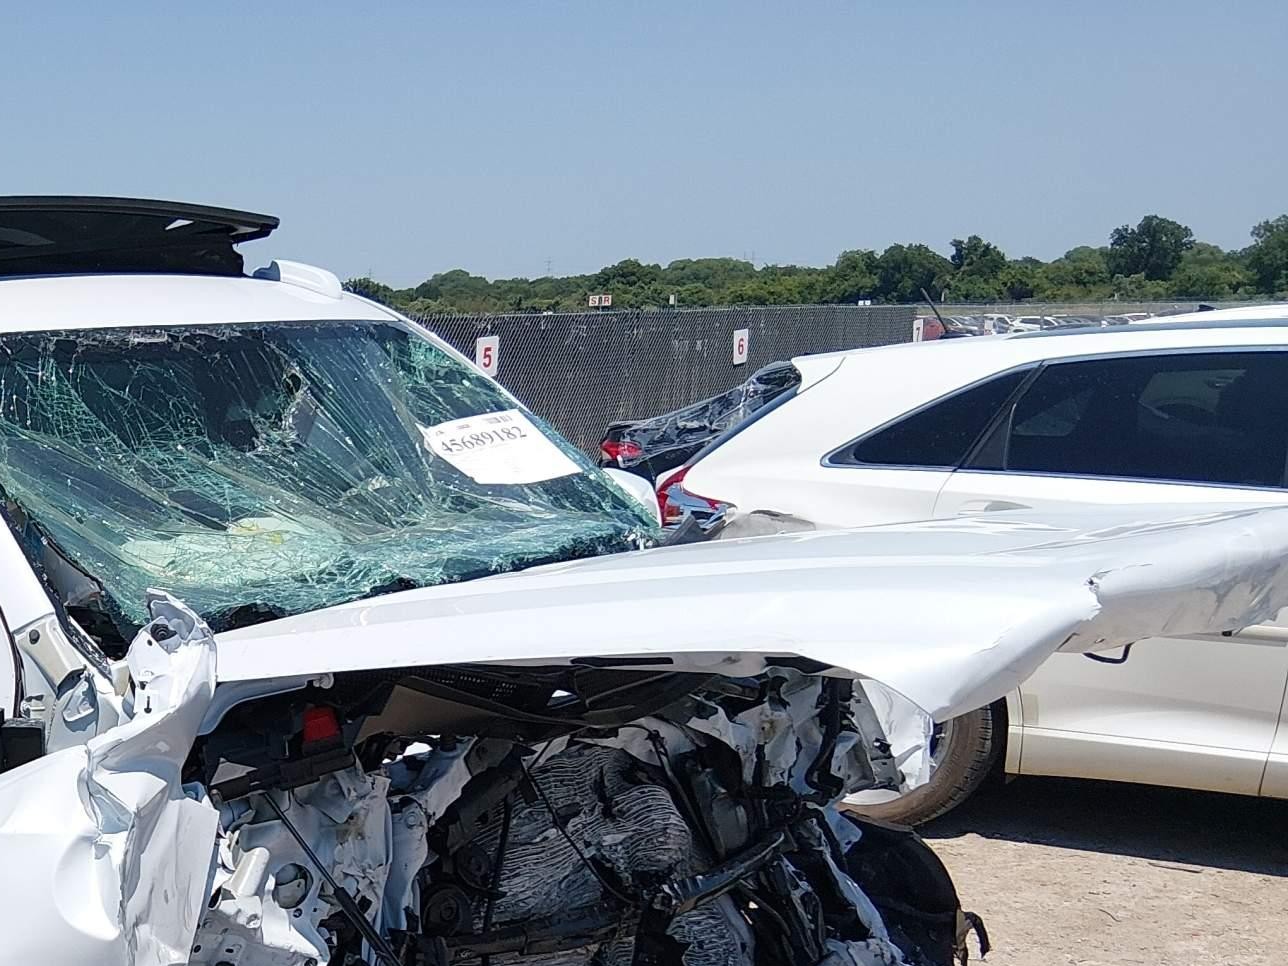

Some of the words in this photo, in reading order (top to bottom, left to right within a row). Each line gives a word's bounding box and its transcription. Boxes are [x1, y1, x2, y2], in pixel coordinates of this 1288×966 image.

[482, 346, 492, 369] 5
[738, 337, 744, 355] 6
[440, 426, 528, 453] 45689182
